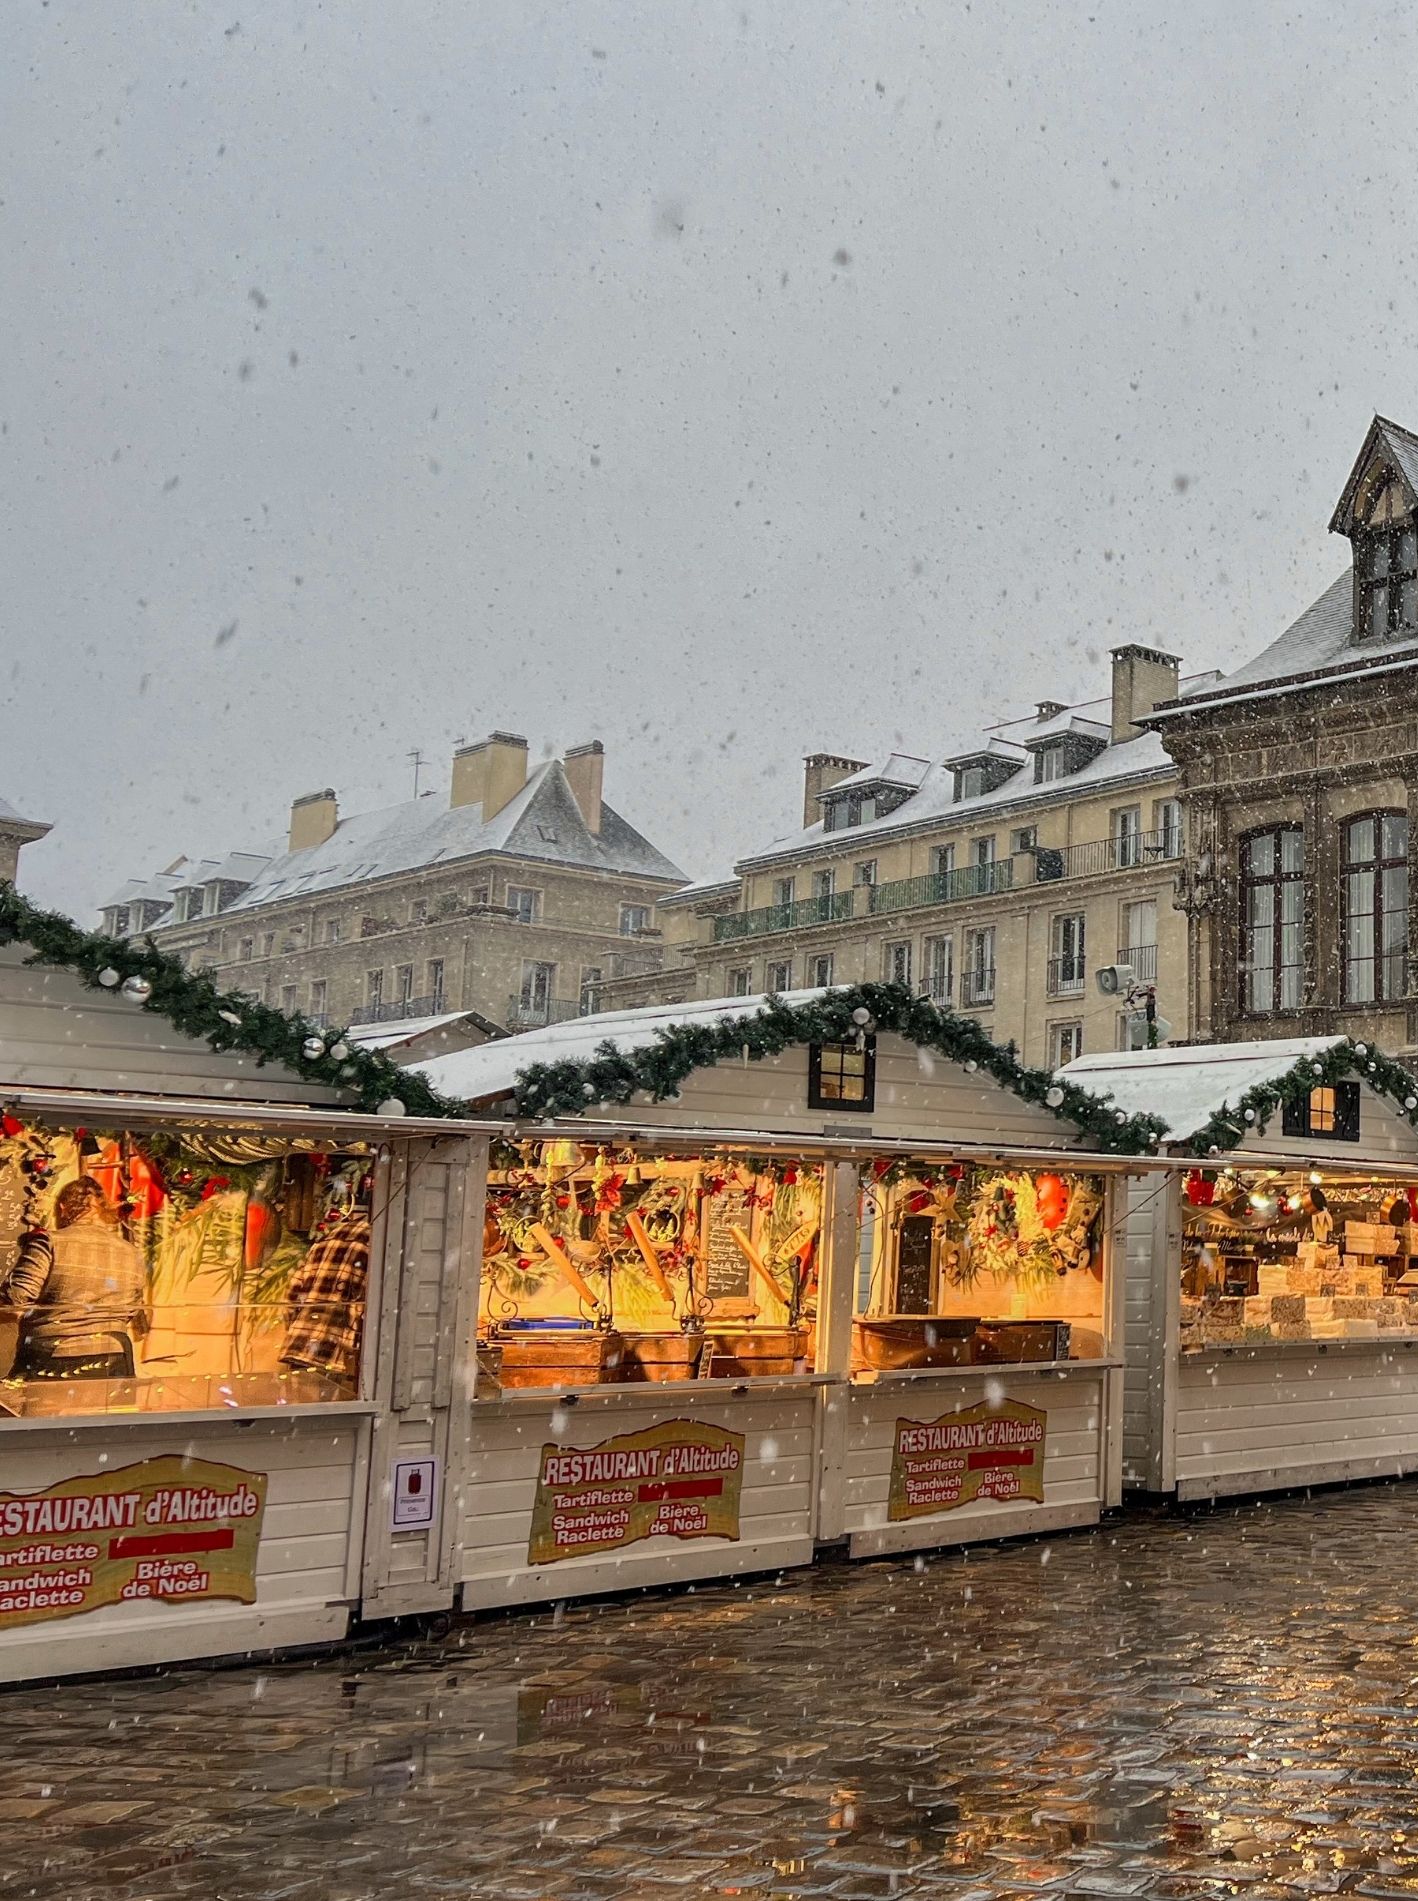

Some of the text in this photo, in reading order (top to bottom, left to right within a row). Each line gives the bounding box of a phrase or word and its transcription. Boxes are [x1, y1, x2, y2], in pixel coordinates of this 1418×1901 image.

[899, 1423, 984, 1453] RESTAURANT
[545, 1450, 661, 1485] RESTAURANT
[906, 1458, 965, 1474] Tartiflette
[906, 1475, 962, 1492] Sandwich
[977, 1481, 1020, 1497] de Noël
[554, 1489, 634, 1509] Tartiflette
[908, 1490, 959, 1505] Raclette
[553, 1510, 629, 1530] Sandwich
[659, 1504, 699, 1520] Bière
[650, 1516, 707, 1534] de Noël
[556, 1527, 625, 1544] Raclette
[138, 1560, 197, 1580] Bière
[0, 1569, 91, 1592] andwich
[122, 1574, 207, 1598] de Noël
[0, 1590, 84, 1610] aclette
